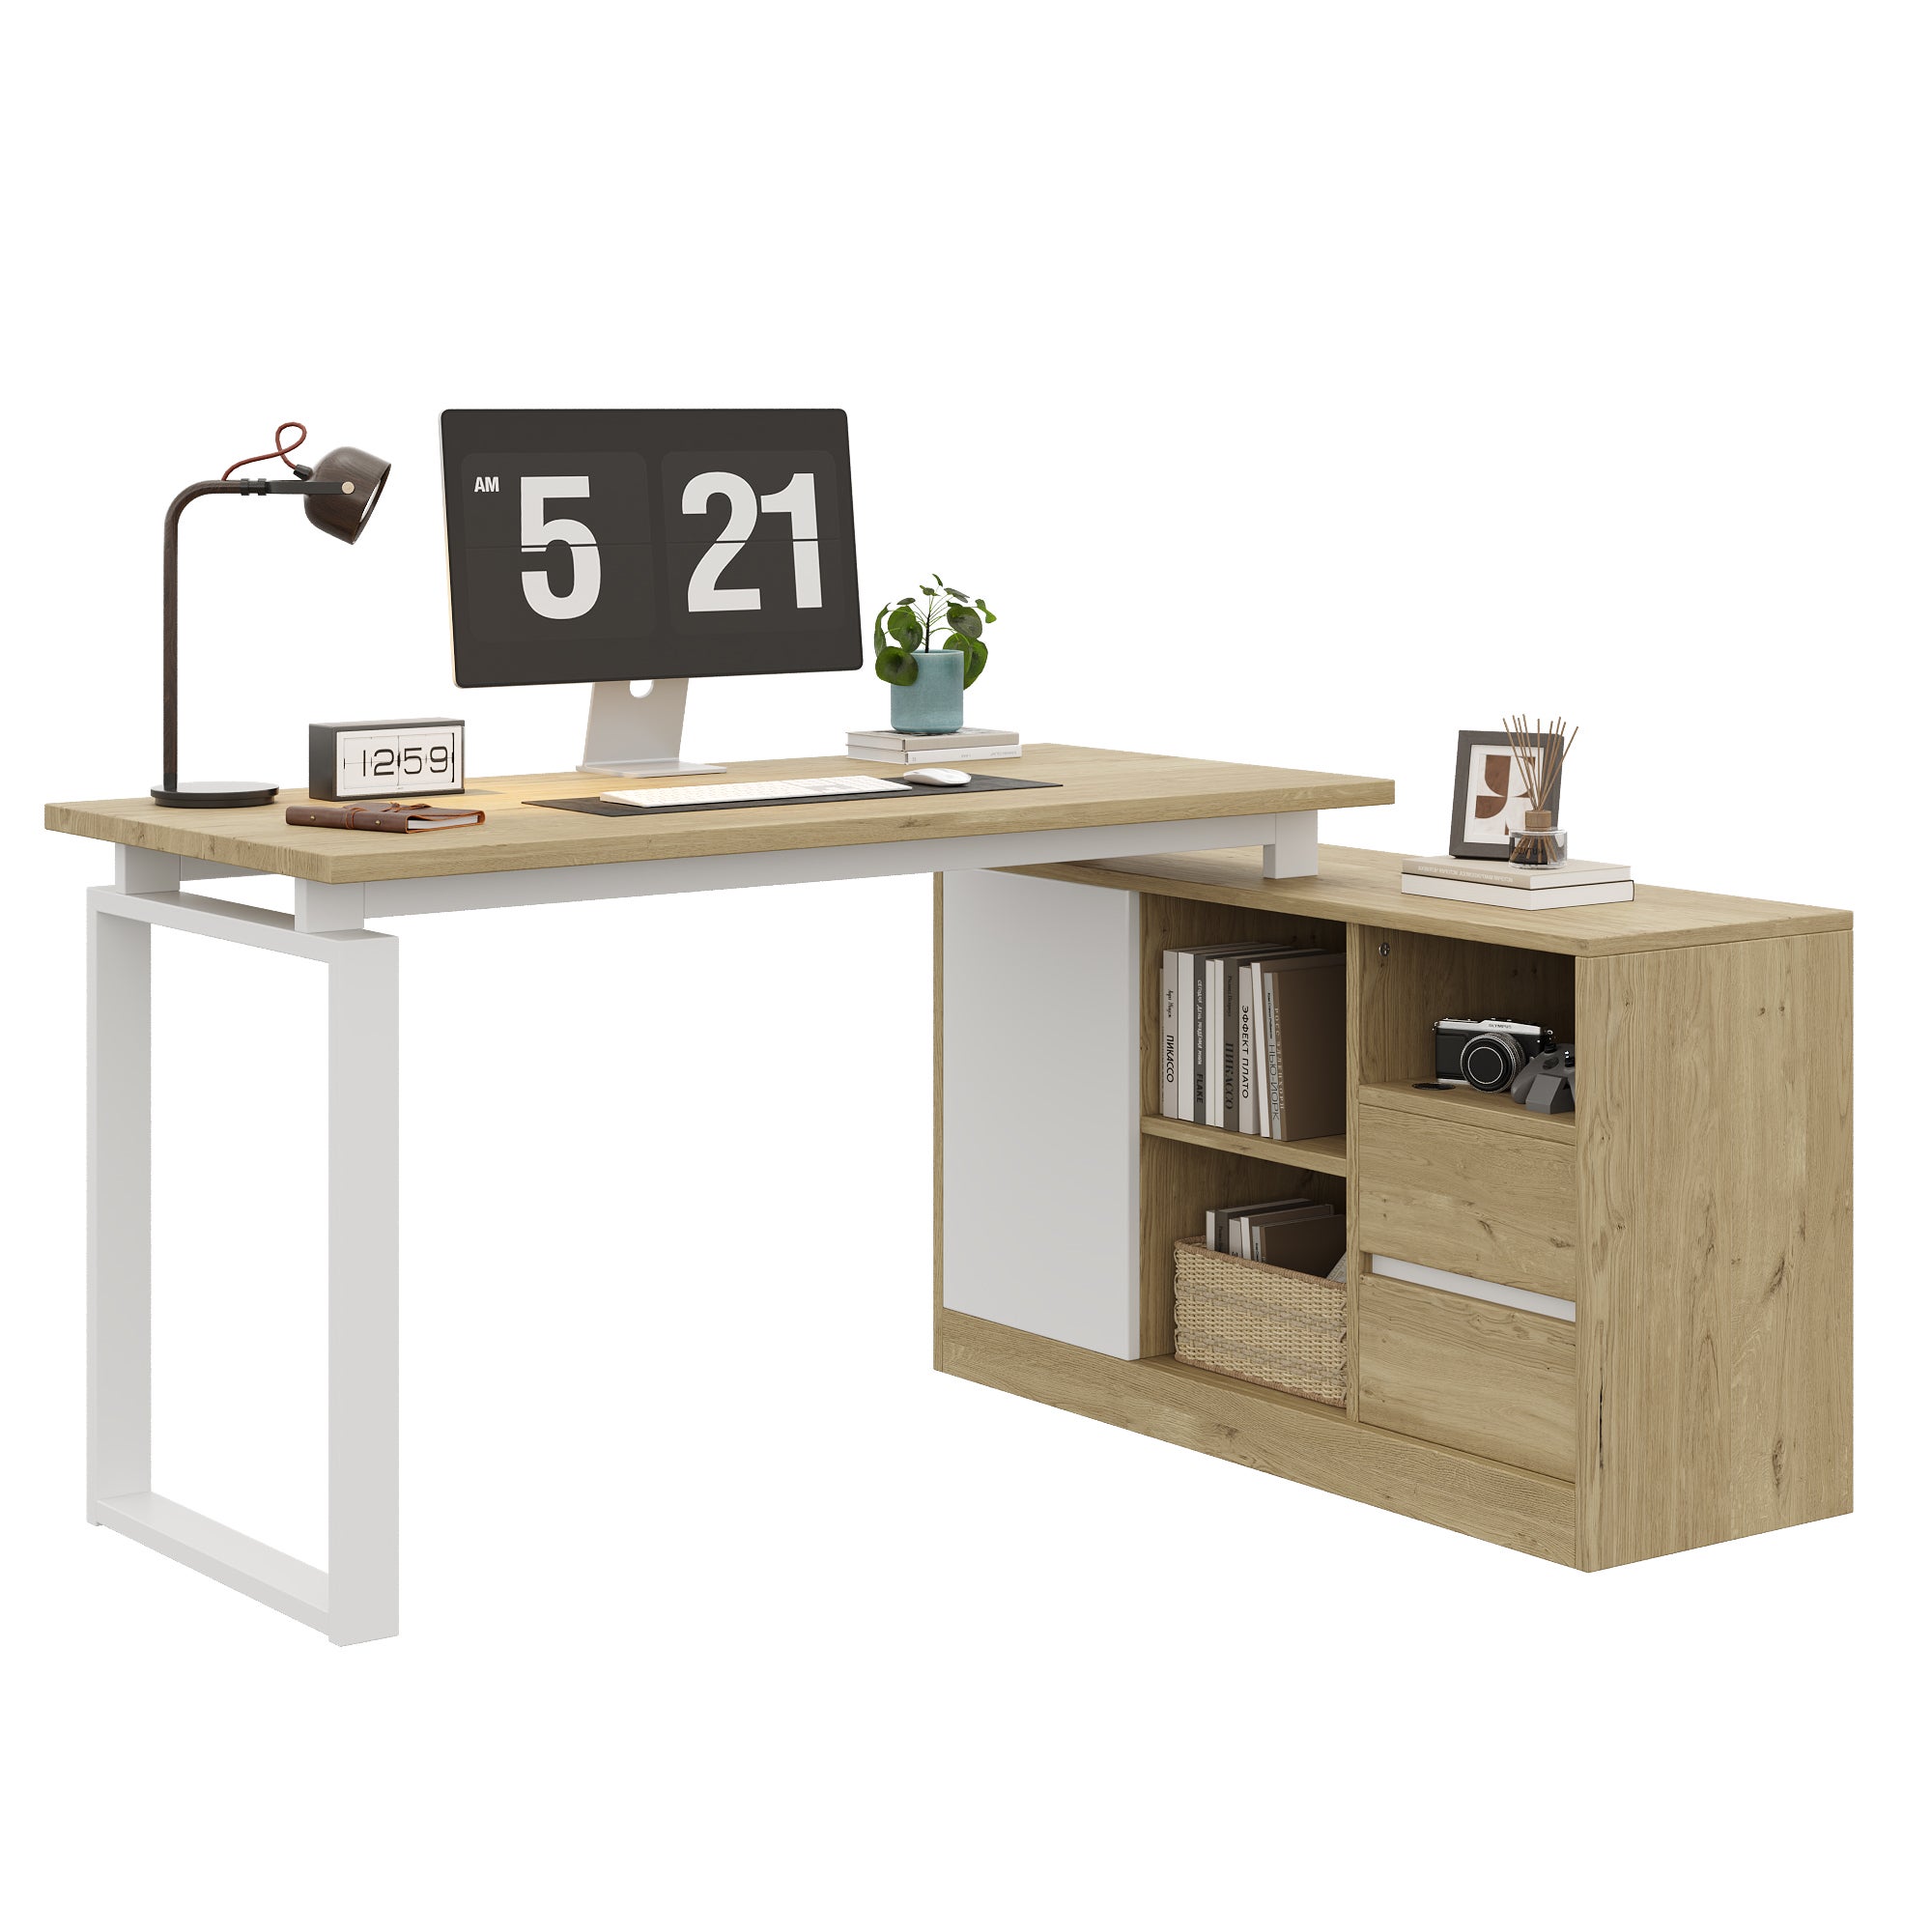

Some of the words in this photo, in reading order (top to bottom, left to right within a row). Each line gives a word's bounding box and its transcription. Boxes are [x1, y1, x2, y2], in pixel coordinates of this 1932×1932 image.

[474, 476, 499, 493] AM
[520, 475, 601, 619] 5
[681, 471, 823, 612] 21
[1166, 1035, 1175, 1083] ПИКАССО
[1225, 1042, 1234, 1110] ПИКАССО
